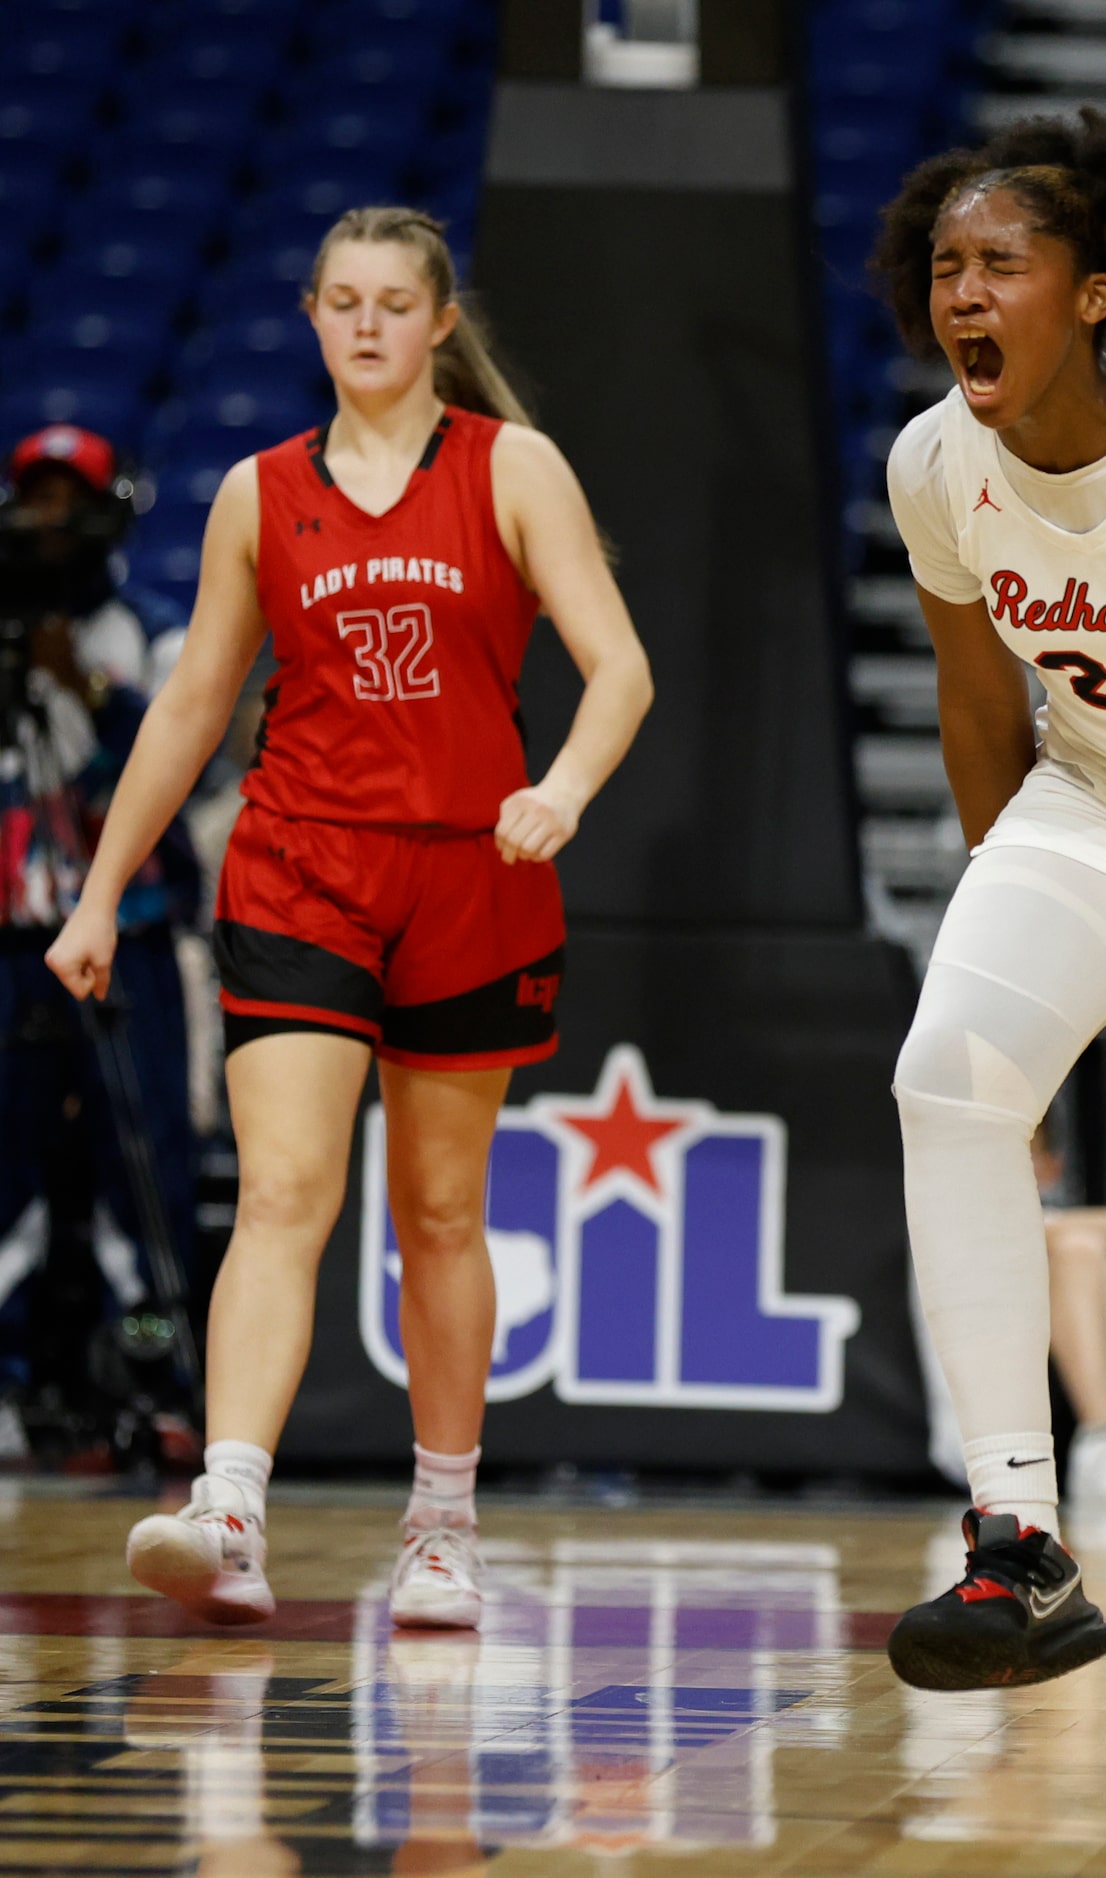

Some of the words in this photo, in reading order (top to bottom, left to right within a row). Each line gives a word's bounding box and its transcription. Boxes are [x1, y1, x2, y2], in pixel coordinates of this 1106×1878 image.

[301, 563, 358, 609] LADY
[366, 556, 464, 594] PIRATES
[336, 602, 441, 700] 32
[358, 1042, 862, 1413] UIL
